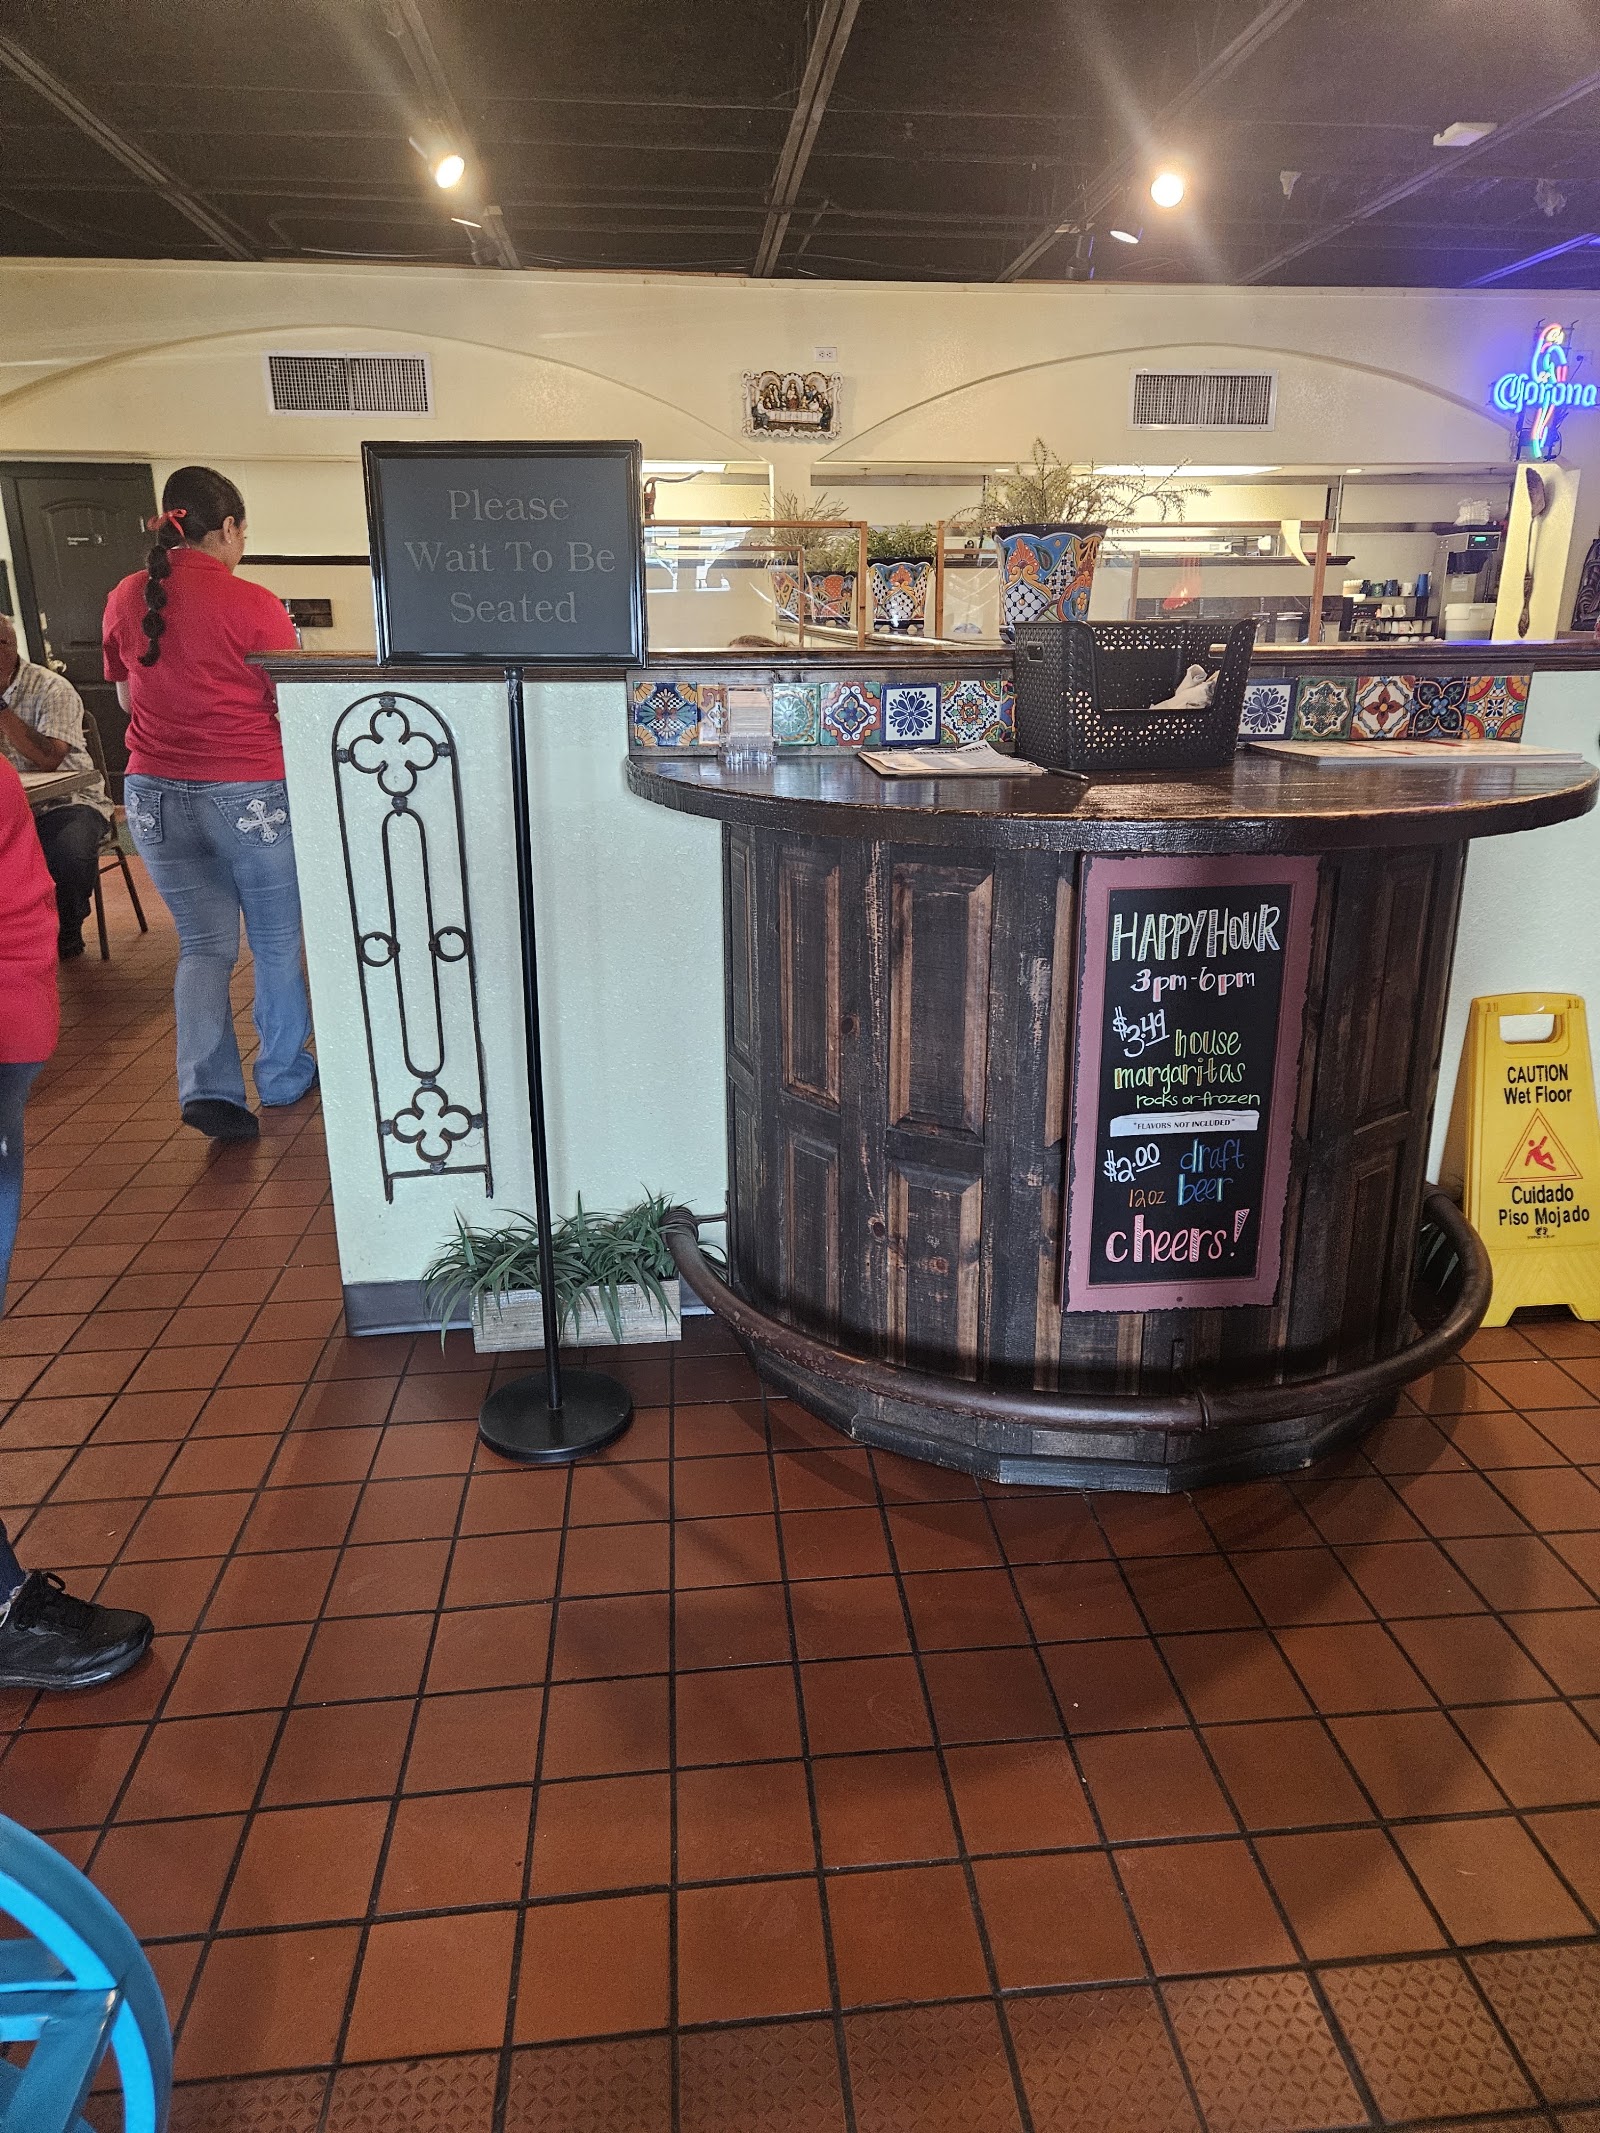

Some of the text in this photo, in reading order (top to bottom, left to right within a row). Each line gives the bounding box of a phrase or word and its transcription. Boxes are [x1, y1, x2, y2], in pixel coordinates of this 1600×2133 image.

[1493, 373, 1598, 413] Corona
[448, 489, 569, 521] Please
[404, 541, 616, 573] Wait To Be
[450, 591, 577, 623] Seated
[1112, 904, 1281, 962] HAPPY HOUR
[1130, 966, 1255, 1003] 3pm-6pm
[1113, 1006, 1241, 1058] $3.49 house
[1114, 1057, 1246, 1094] margaritas
[1507, 1063, 1569, 1084] CAUTION
[1136, 1091, 1261, 1109] rocks or frozen
[1503, 1085, 1573, 1105] Wet Floor
[1103, 1138, 1245, 1183] $2.00 draft
[1178, 1173, 1233, 1206] beer
[1511, 1183, 1574, 1205] Cuidado
[1498, 1205, 1590, 1228] Piso Mojado
[1106, 1208, 1250, 1264] cheers!
